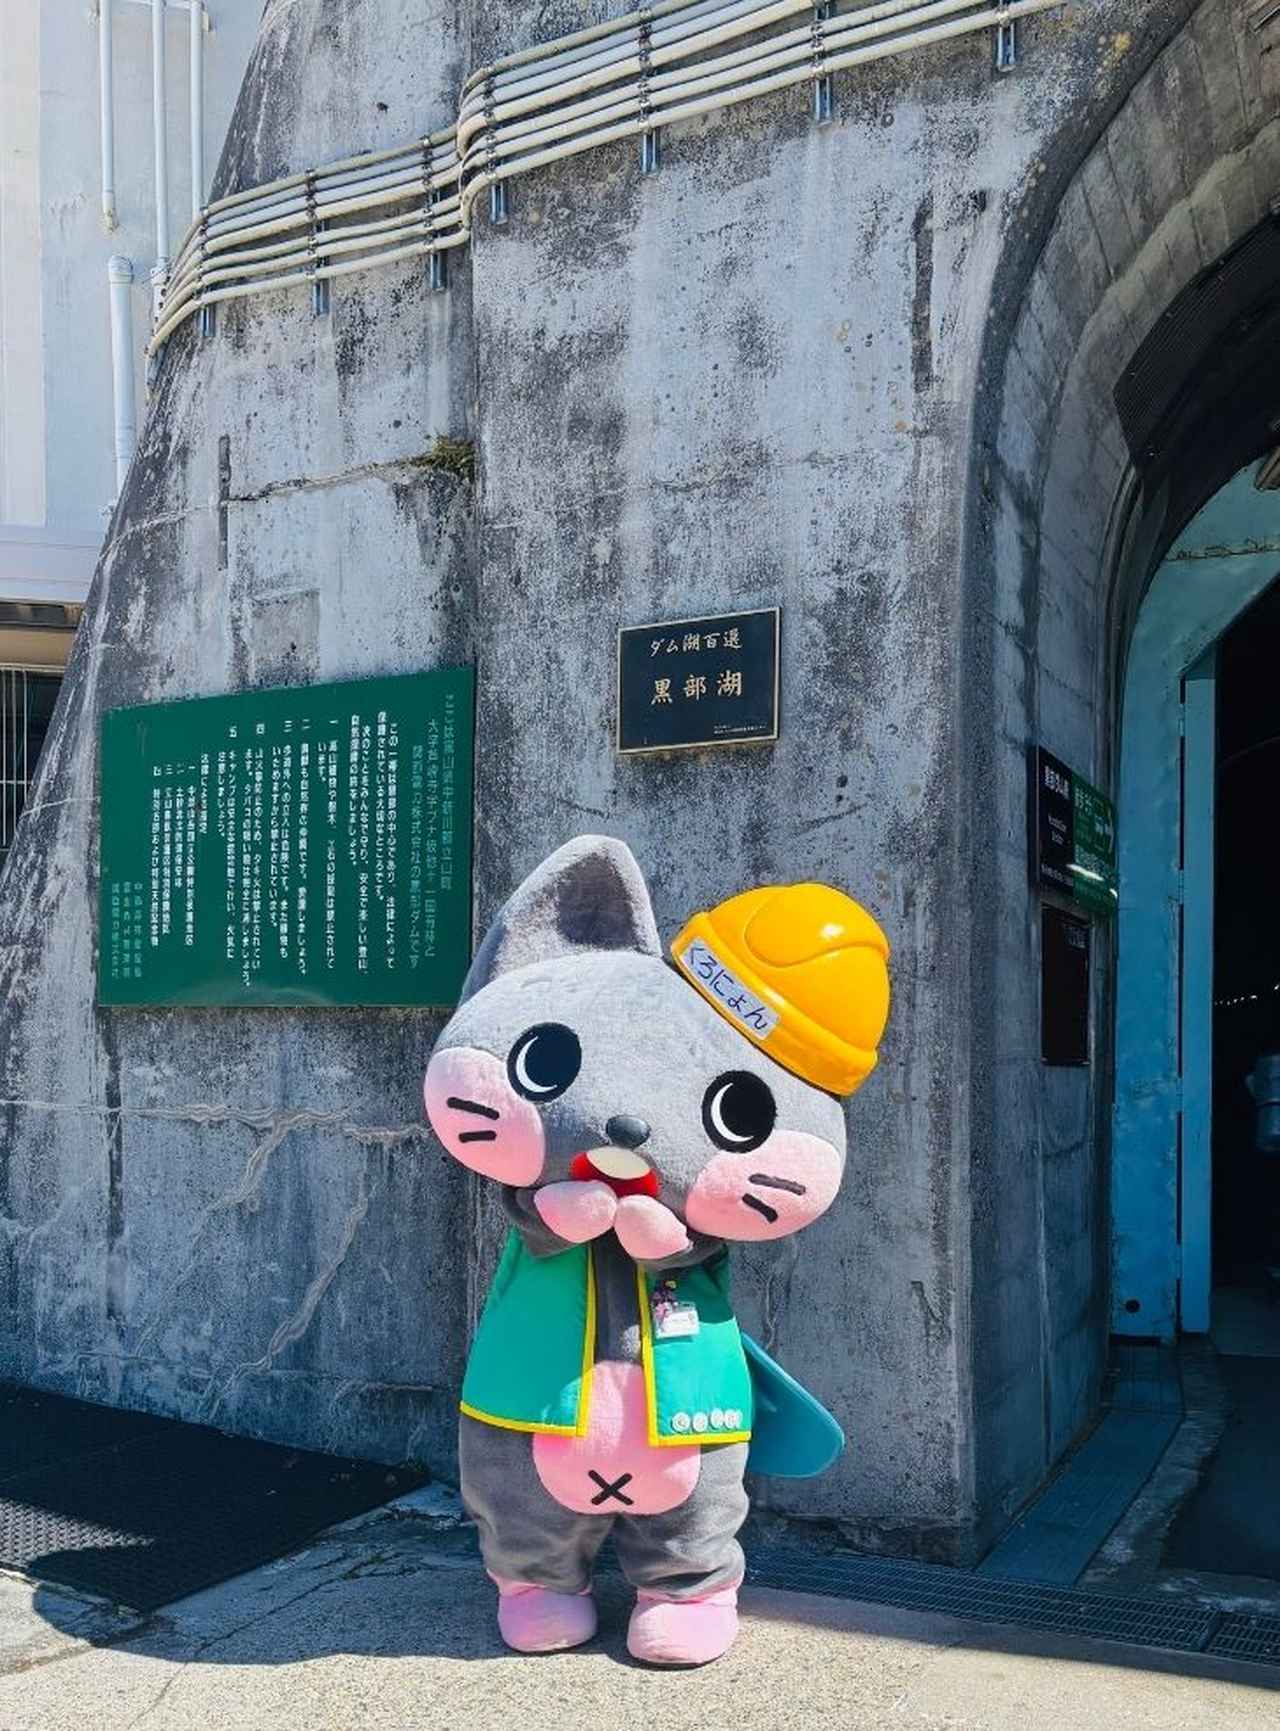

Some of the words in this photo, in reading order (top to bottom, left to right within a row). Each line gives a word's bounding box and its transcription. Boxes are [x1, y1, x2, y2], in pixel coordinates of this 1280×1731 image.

[650, 627, 743, 657] ダム湖百選
[650, 668, 743, 705] 黒部湖
[283, 720, 293, 732] 三
[302, 718, 311, 730] 二
[165, 764, 173, 775] 三
[176, 763, 185, 775] 二
[318, 742, 326, 782] います。
[690, 946, 768, 1030] くろにょん
